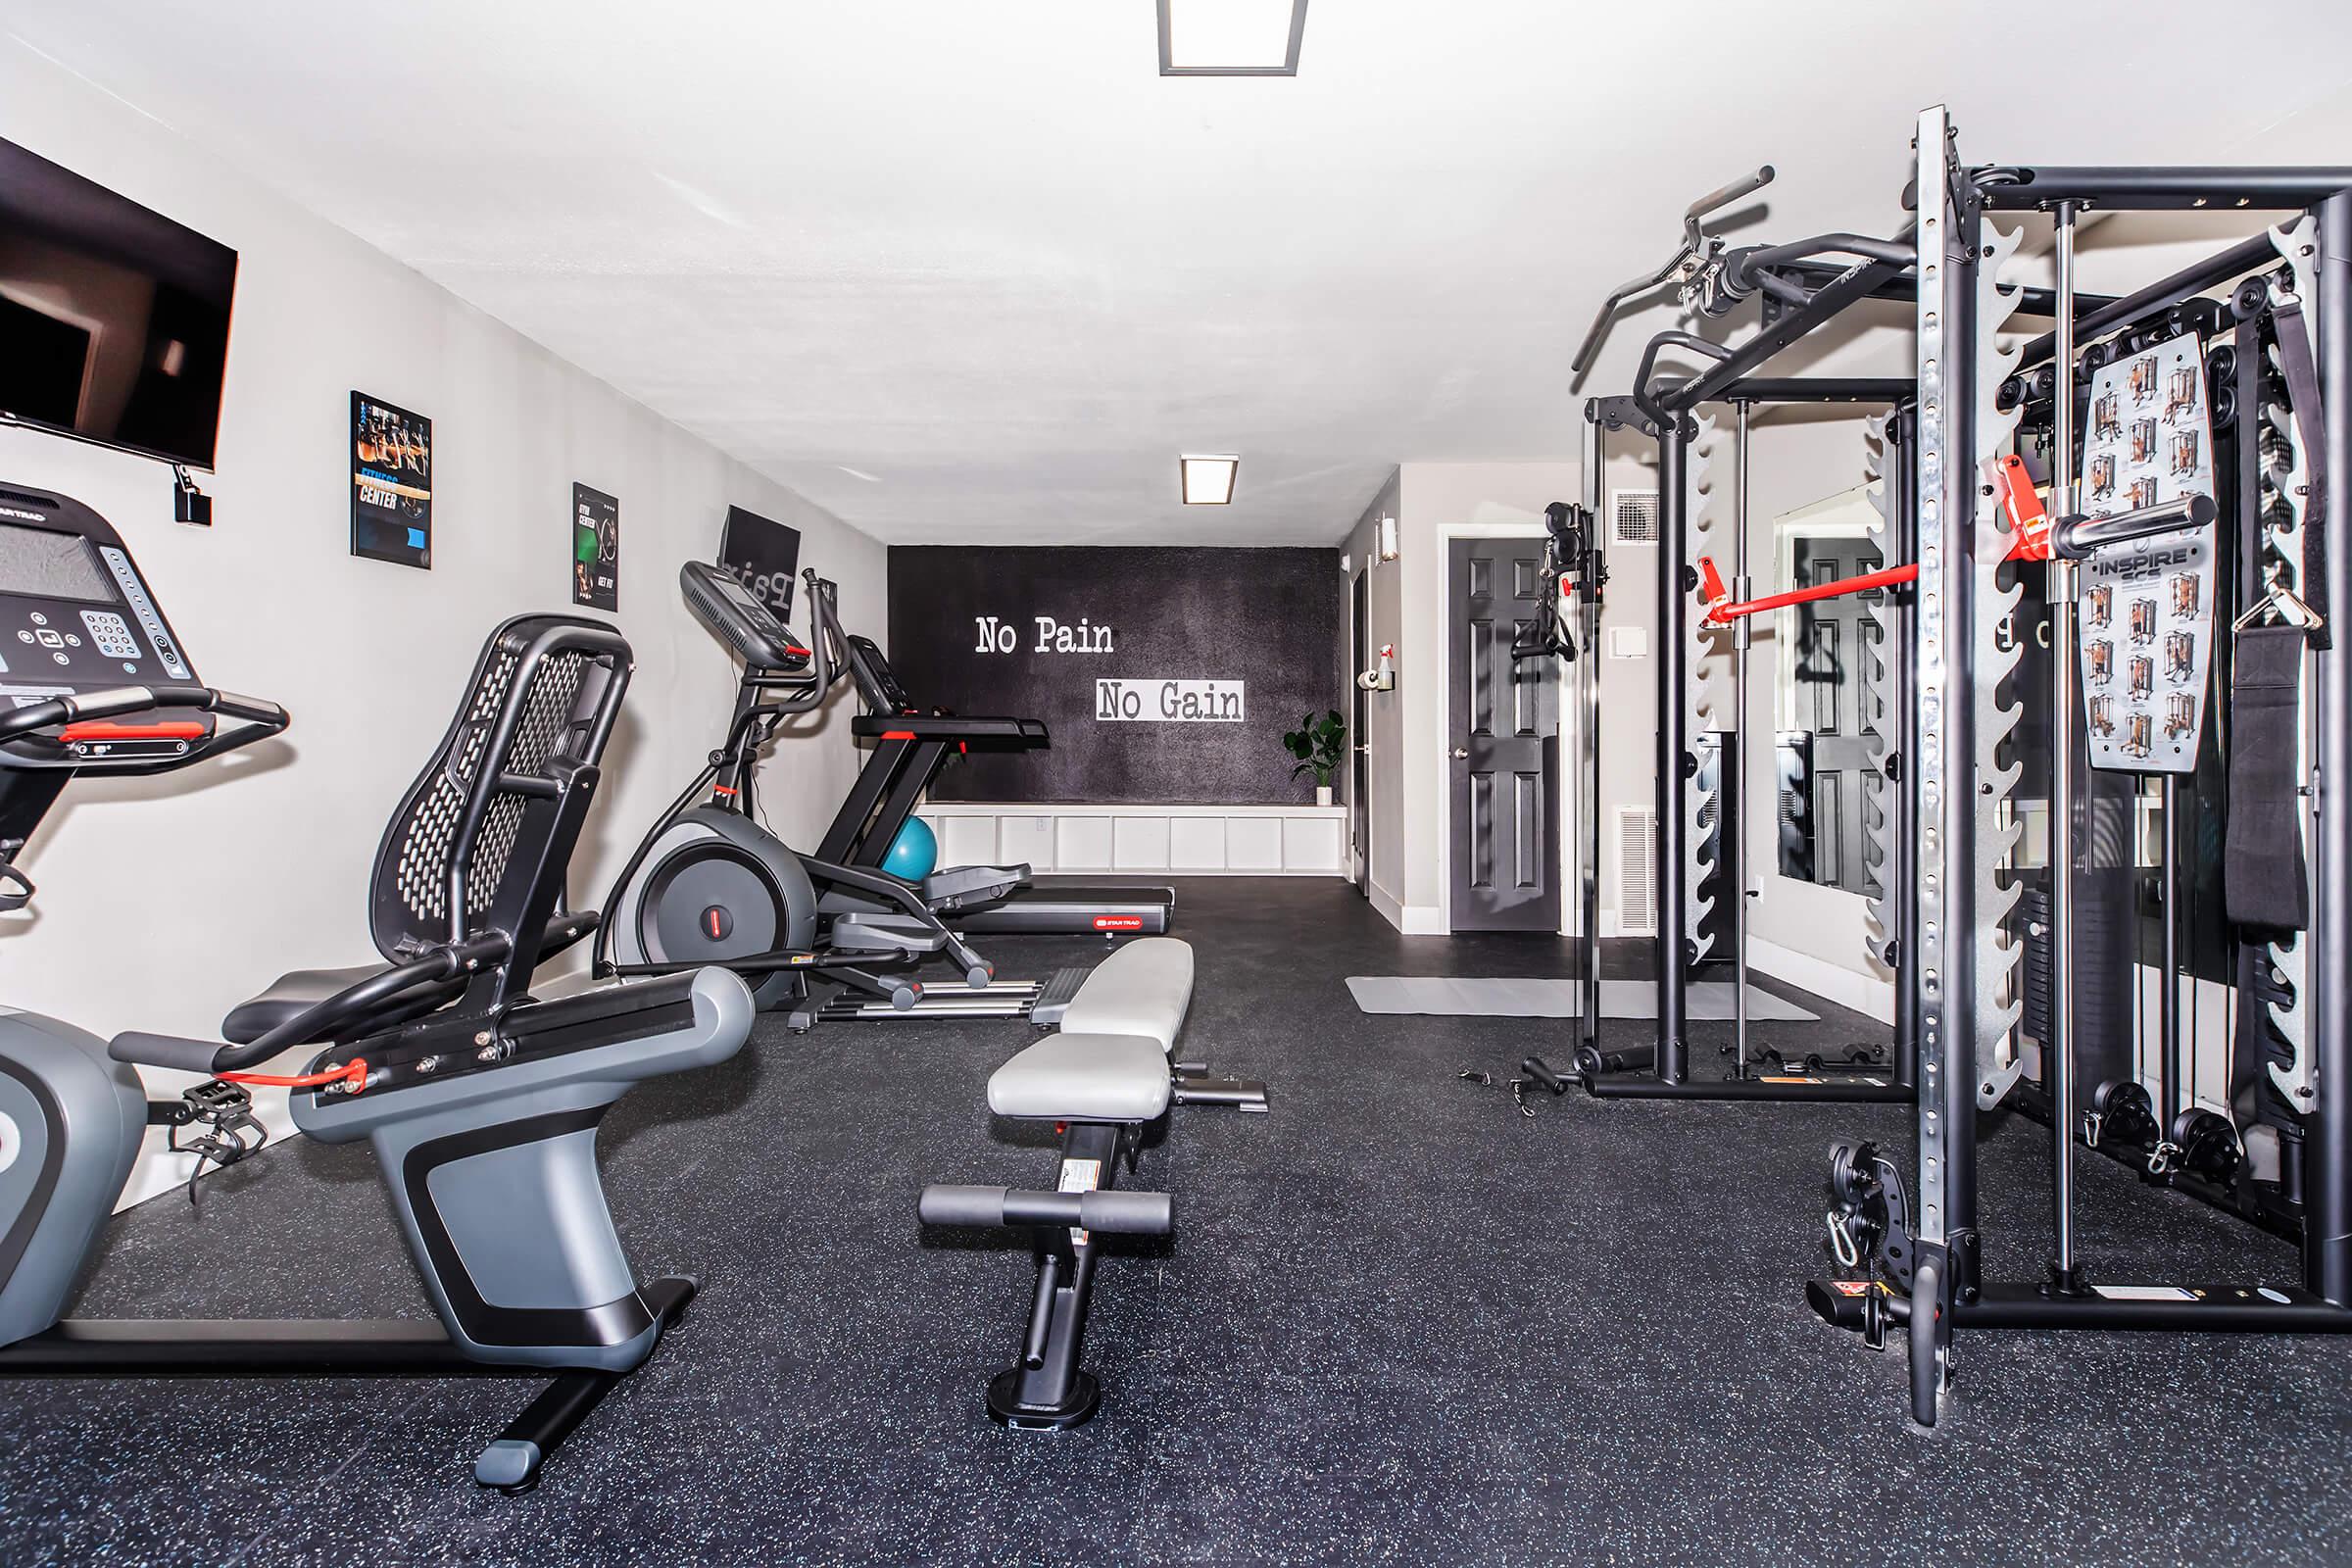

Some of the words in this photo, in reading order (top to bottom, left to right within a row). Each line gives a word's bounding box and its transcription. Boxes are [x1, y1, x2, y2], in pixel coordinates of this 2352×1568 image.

[360, 485, 398, 510] CENTER
[2099, 548, 2187, 576] INSPIRE
[2121, 567, 2162, 581] SCS
[975, 616, 1017, 654] No
[1034, 616, 1114, 654] Pain
[1099, 681, 1142, 719] No
[1160, 681, 1242, 719] Gain
